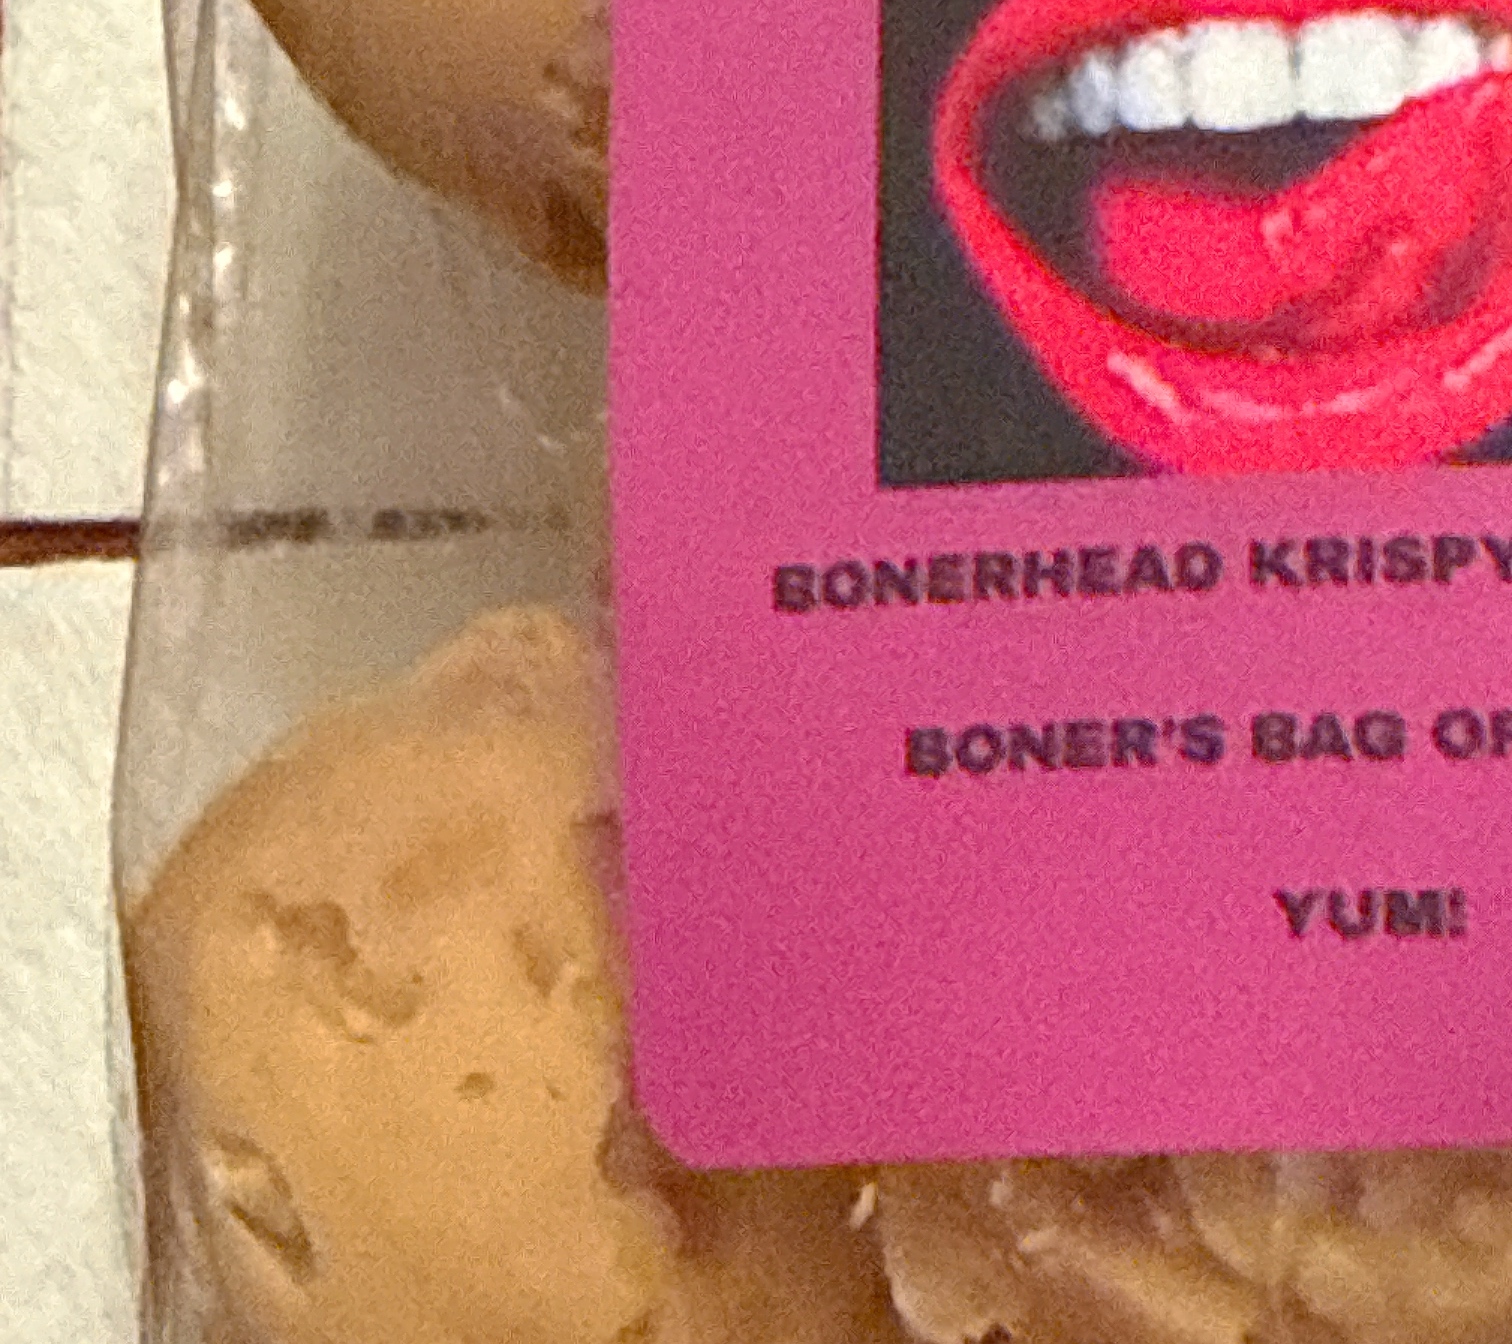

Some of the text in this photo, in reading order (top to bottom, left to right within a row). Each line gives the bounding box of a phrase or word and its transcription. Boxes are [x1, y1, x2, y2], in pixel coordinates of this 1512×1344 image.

[773, 540, 1223, 614] BONERHEAD
[905, 713, 1226, 777] BONER'S
[1251, 709, 1407, 763] BAG
[1273, 886, 1468, 940] YUM!
